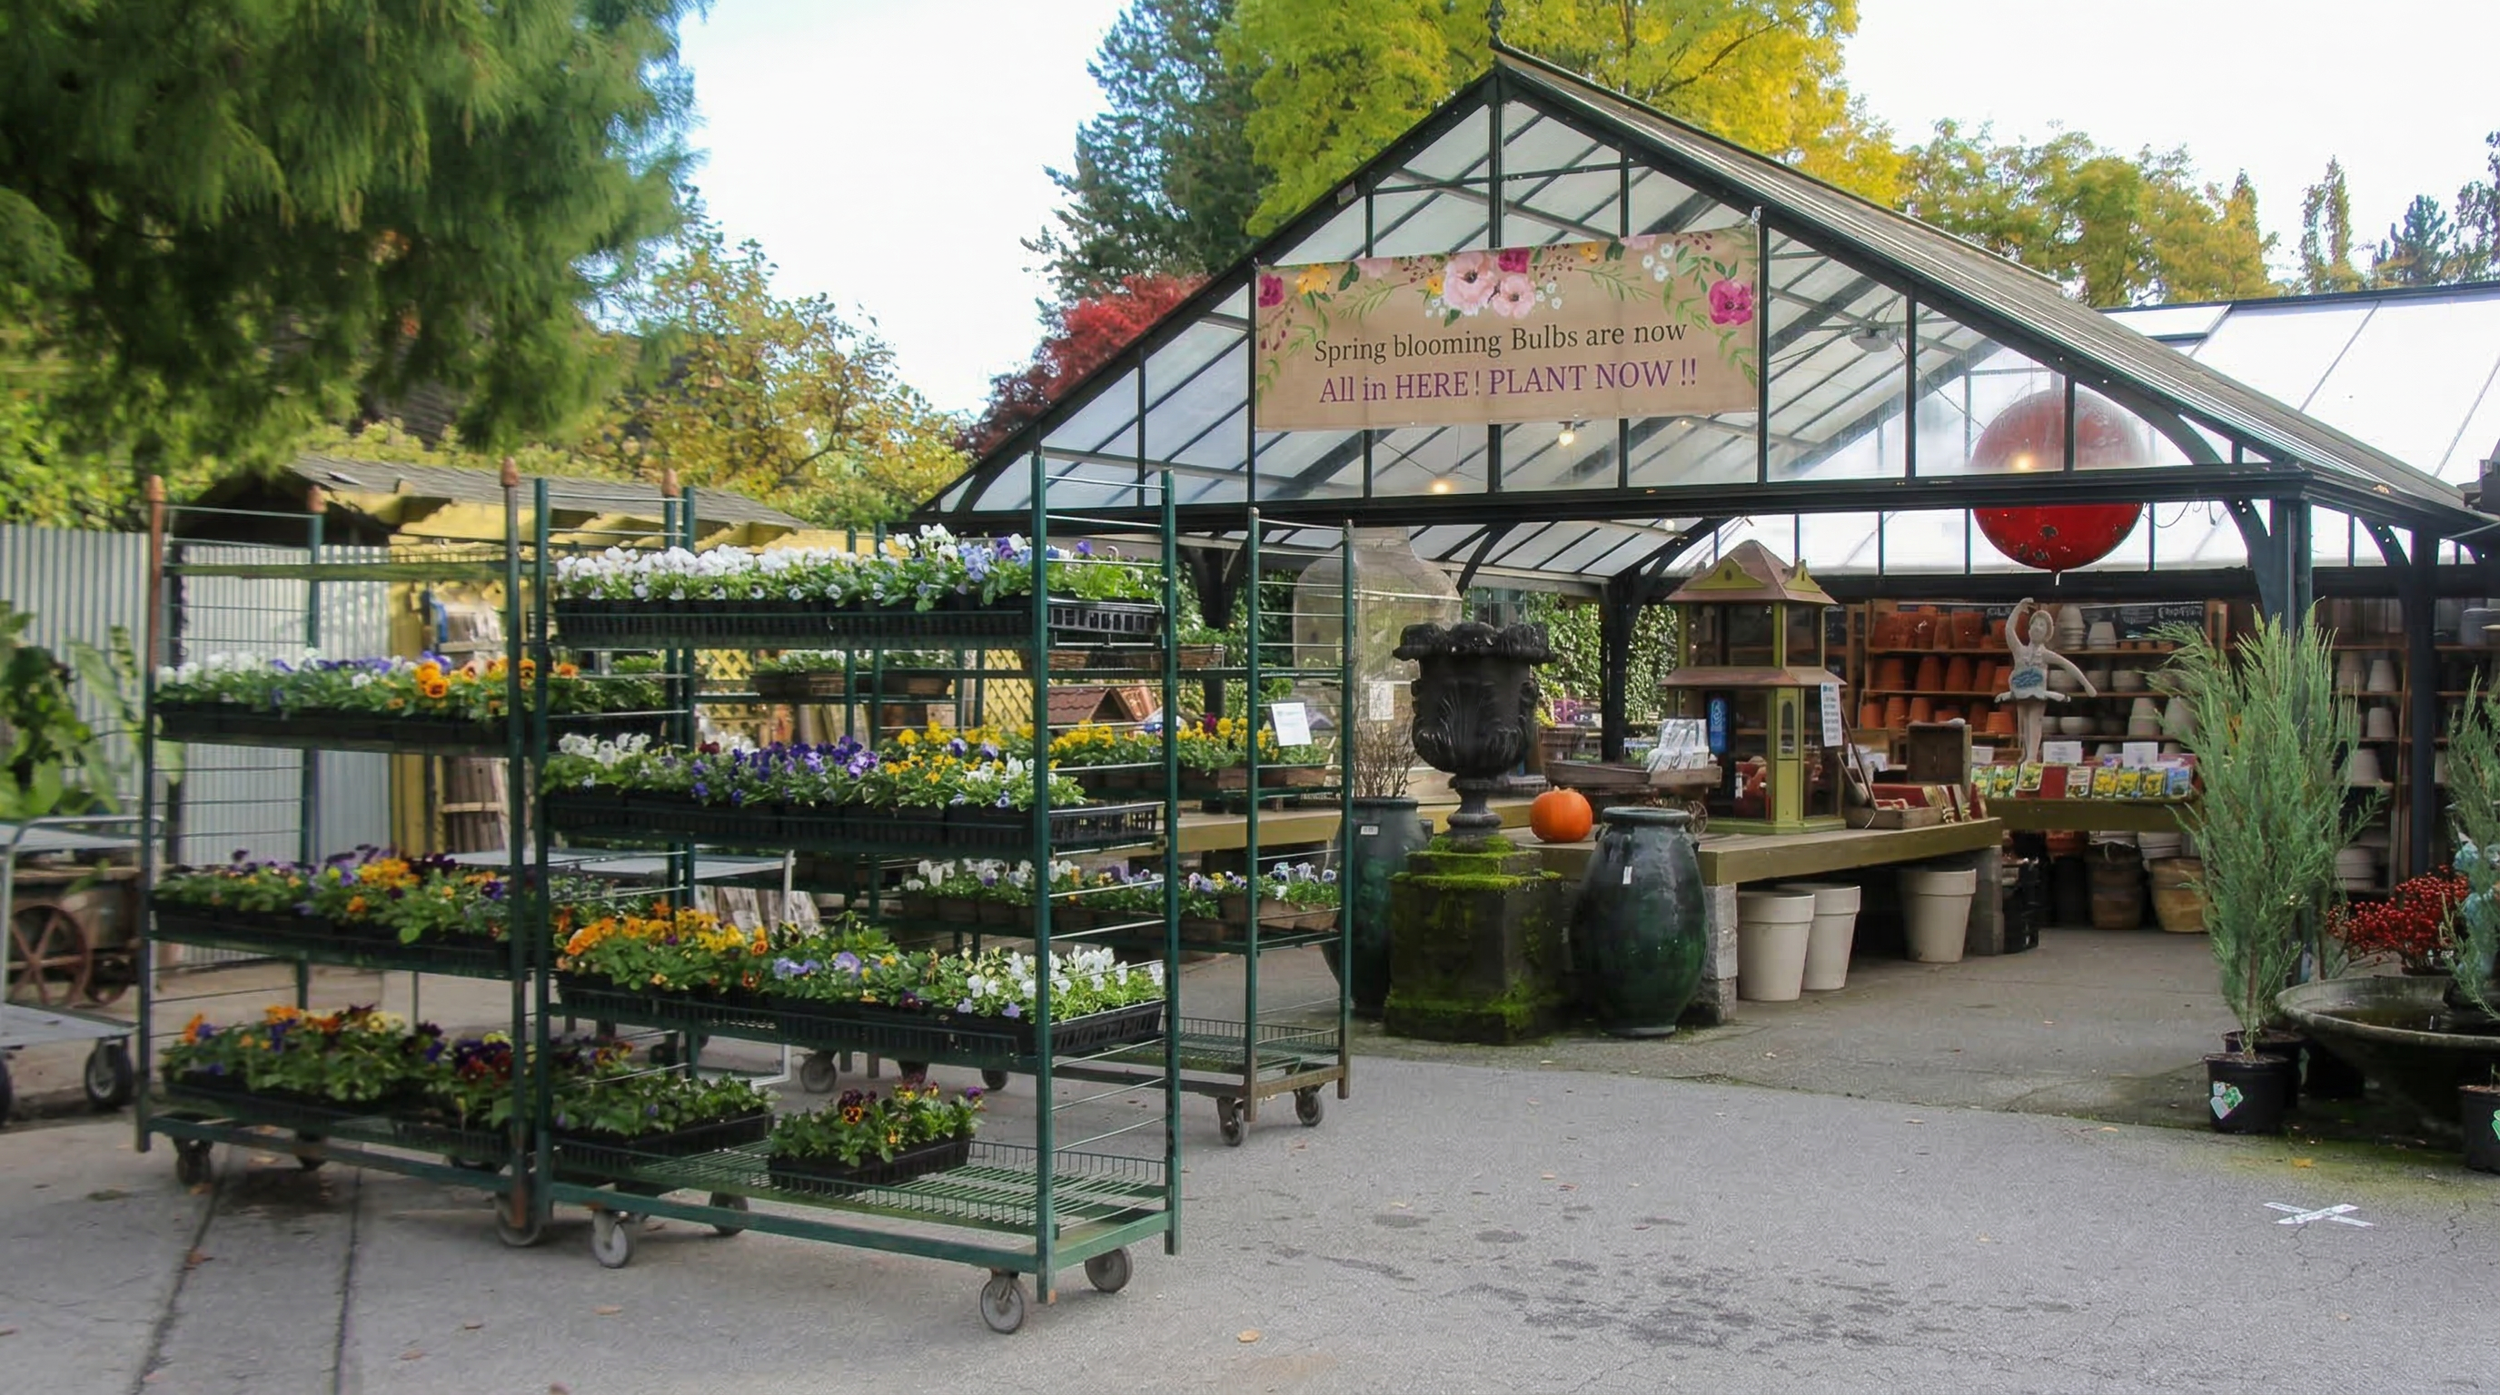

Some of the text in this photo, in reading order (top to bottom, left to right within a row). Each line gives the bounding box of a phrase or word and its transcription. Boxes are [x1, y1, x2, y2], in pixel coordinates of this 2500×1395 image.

[1313, 322, 1688, 368] Spring blooming Bulbs are now
[1318, 376, 1355, 404] All
[1362, 375, 1387, 401] in
[1488, 365, 1588, 395] PLANT
